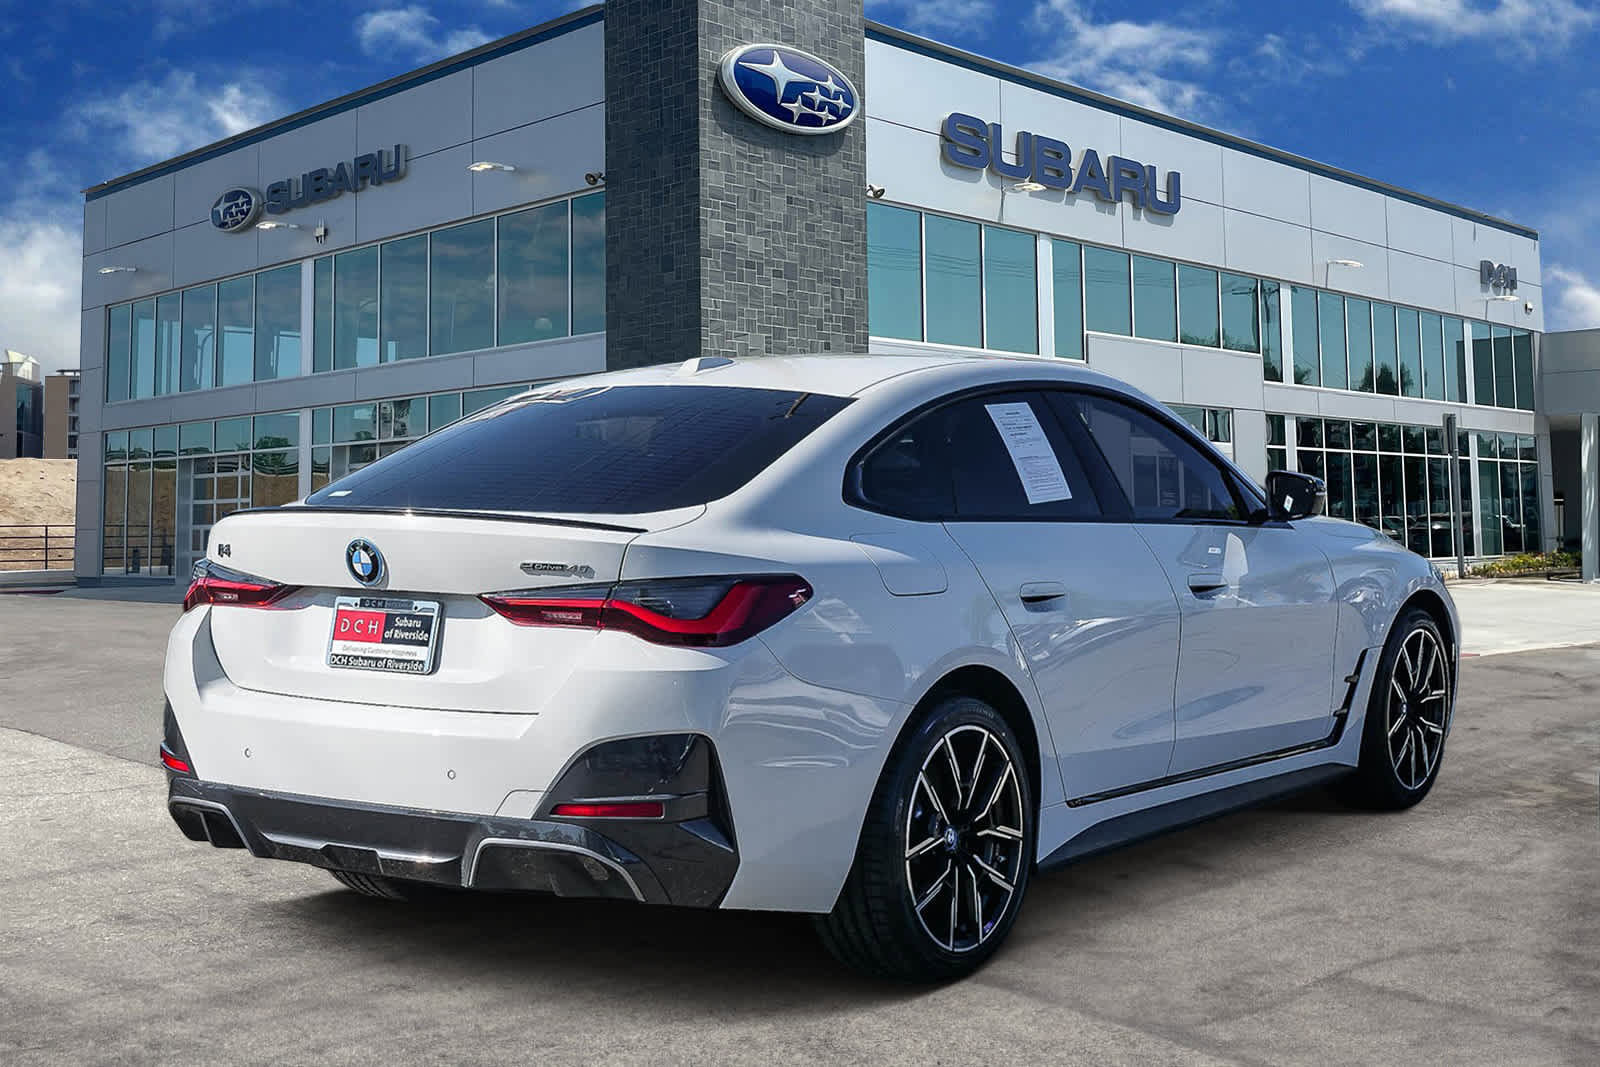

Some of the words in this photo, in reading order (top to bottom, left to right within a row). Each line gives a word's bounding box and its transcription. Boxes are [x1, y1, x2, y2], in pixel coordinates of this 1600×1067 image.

[942, 112, 1181, 215] SUBARU
[266, 144, 406, 215] SUBARU
[340, 618, 379, 636] DCH
[394, 617, 422, 628] Subaru
[384, 629, 394, 639] of
[394, 629, 429, 641] Riverside
[330, 656, 348, 665] DCH
[348, 656, 376, 668] Subaru
[377, 659, 387, 668] of
[387, 660, 424, 672] Riverside
